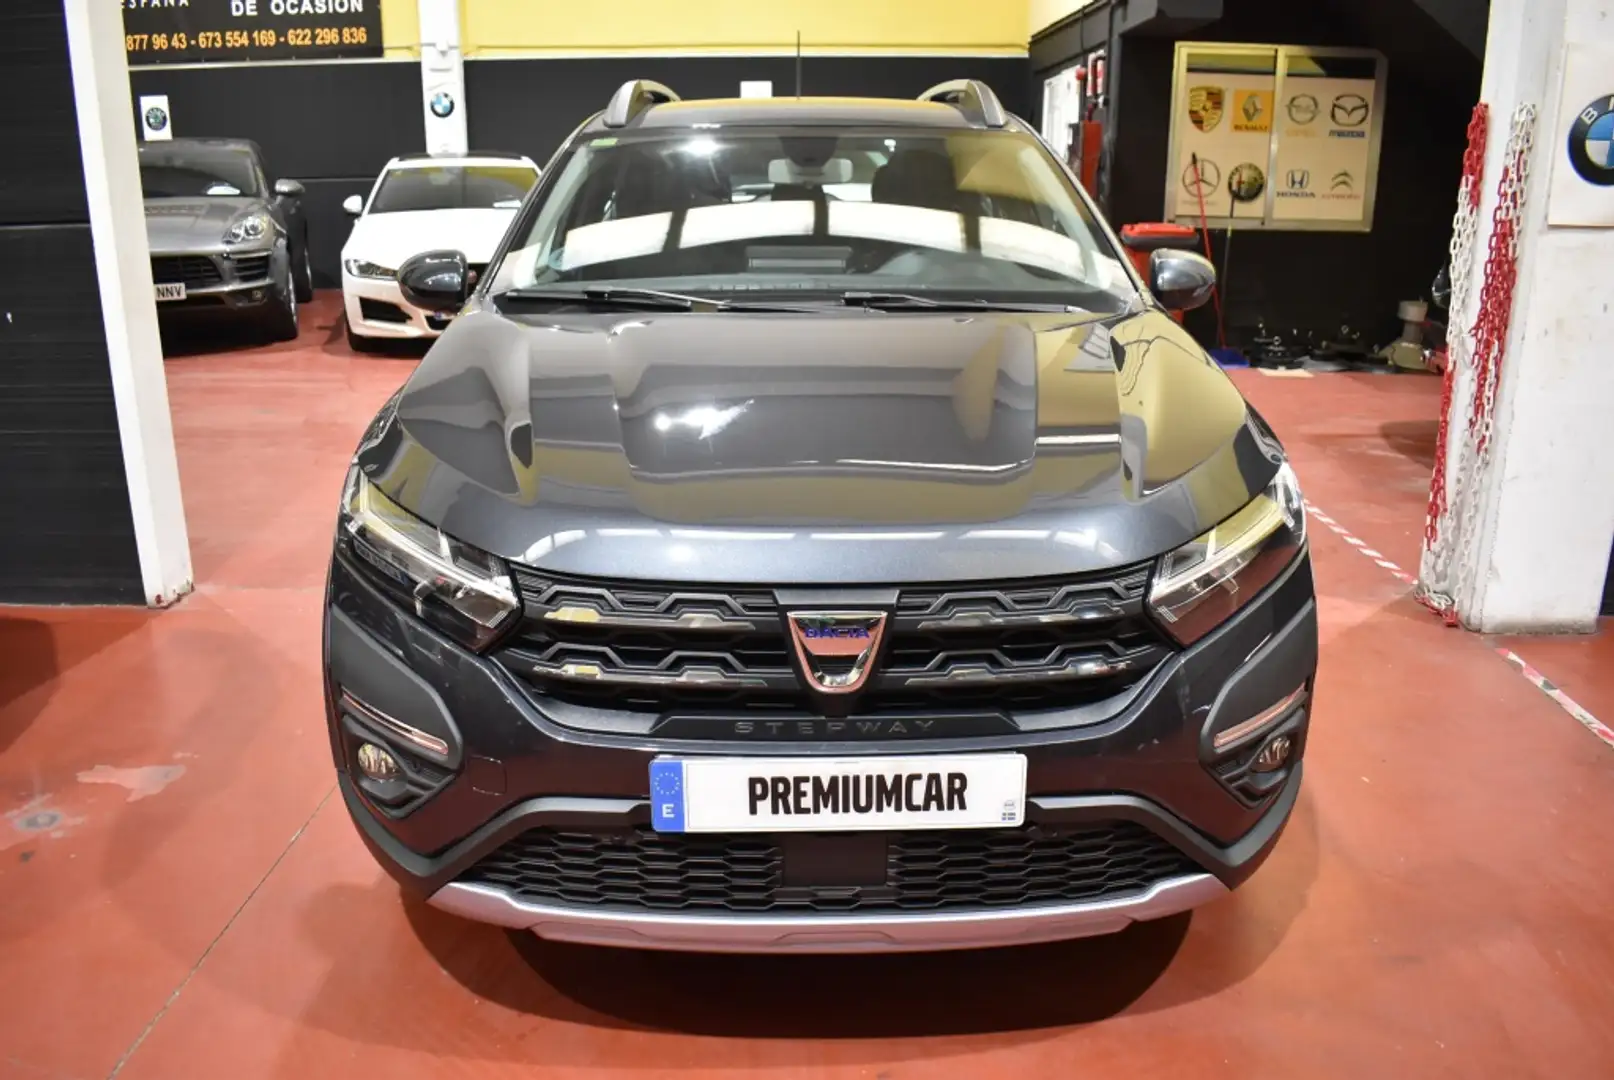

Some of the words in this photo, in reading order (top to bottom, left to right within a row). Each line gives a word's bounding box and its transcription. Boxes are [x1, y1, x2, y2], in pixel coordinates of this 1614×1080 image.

[231, 0, 258, 16] DE
[126, 34, 149, 51] 877
[152, 33, 168, 50] 96
[171, 32, 187, 49] 43
[199, 31, 222, 48] 673
[225, 30, 249, 48] 554
[252, 29, 276, 47] 169
[287, 28, 312, 46] 622
[315, 27, 340, 45] 296
[342, 26, 367, 44] 836
[156, 285, 181, 298] NNV
[805, 627, 870, 638] DACIA
[734, 720, 934, 734] STEPWAY
[661, 803, 675, 818] E
[748, 772, 968, 816] PREMIUMCAR
